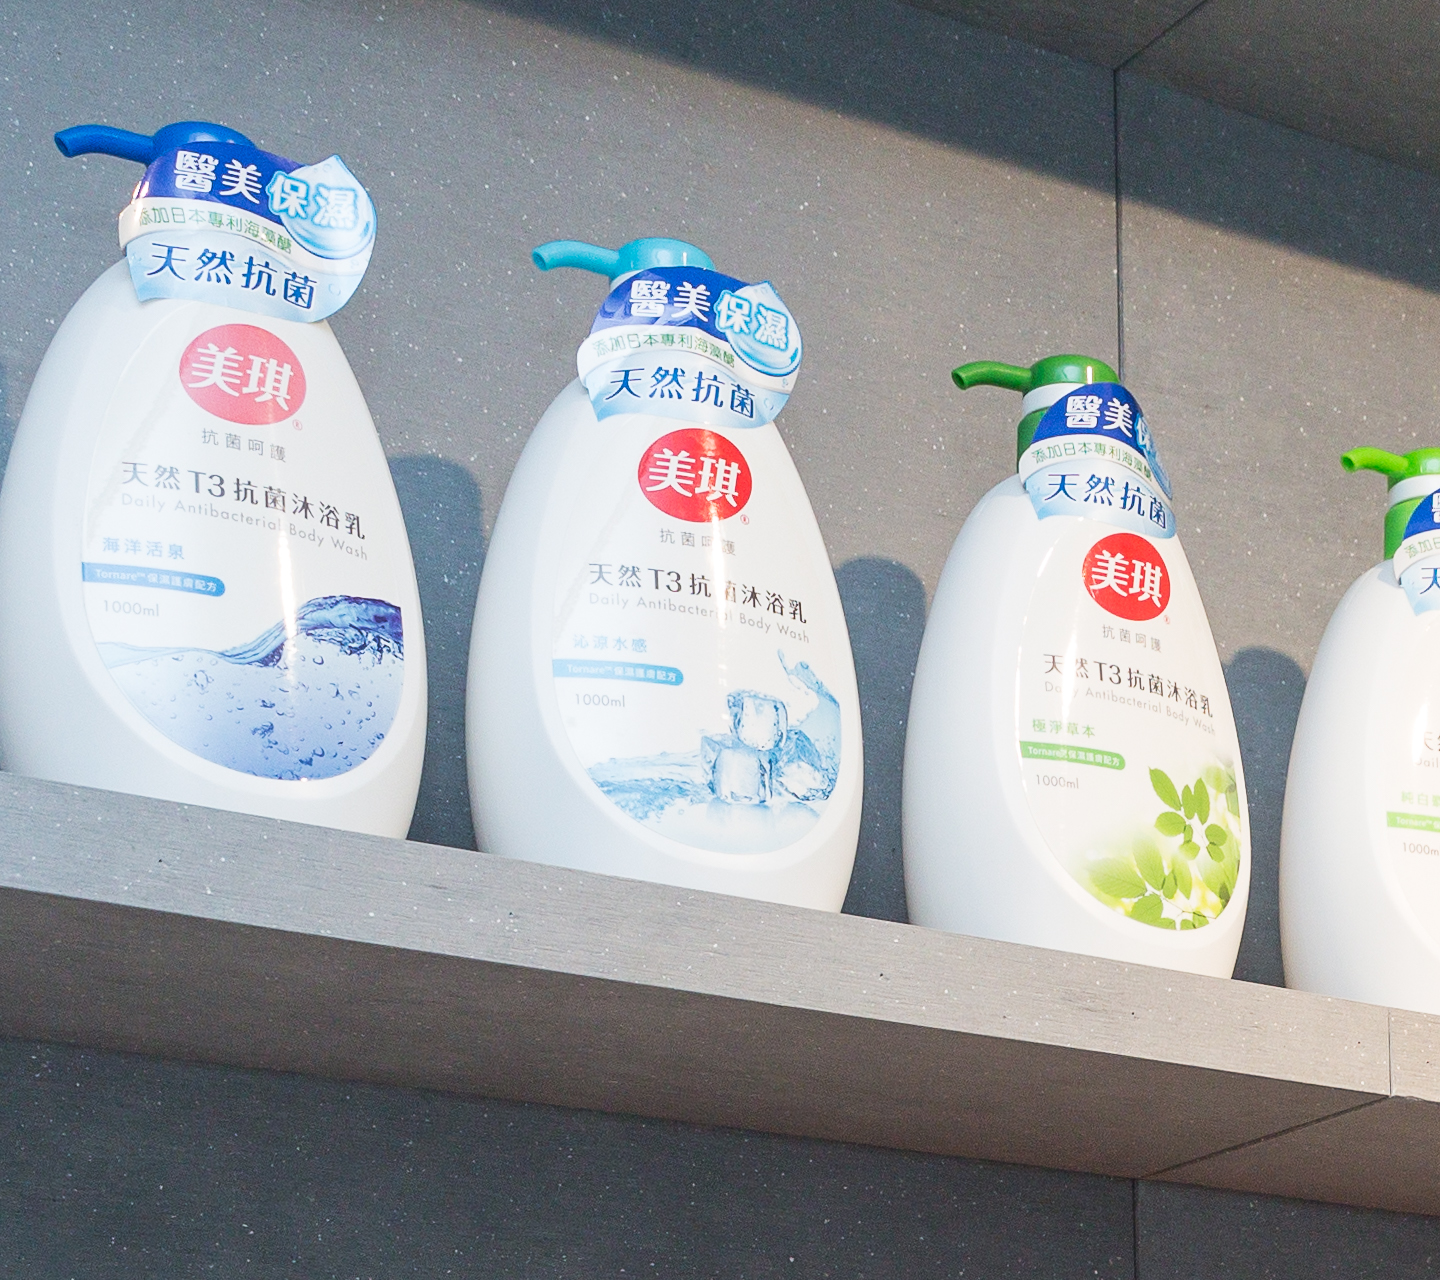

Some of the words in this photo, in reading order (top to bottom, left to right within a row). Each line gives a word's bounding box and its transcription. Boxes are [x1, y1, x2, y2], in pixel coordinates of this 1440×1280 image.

[147, 243, 318, 310] 天然抗菌
[187, 343, 295, 412] 美琪
[605, 366, 756, 419] 天然抗菌
[121, 493, 166, 514] Daily
[174, 498, 279, 531] Antibacterial
[289, 522, 325, 548] Body
[330, 536, 369, 561] Wash
[102, 536, 185, 561] 海洋活泉
[103, 600, 160, 617] 1000ml
[573, 634, 648, 653] 沁涼水感
[574, 693, 626, 708] 1000ml
[1035, 774, 1079, 789] 1000ml
